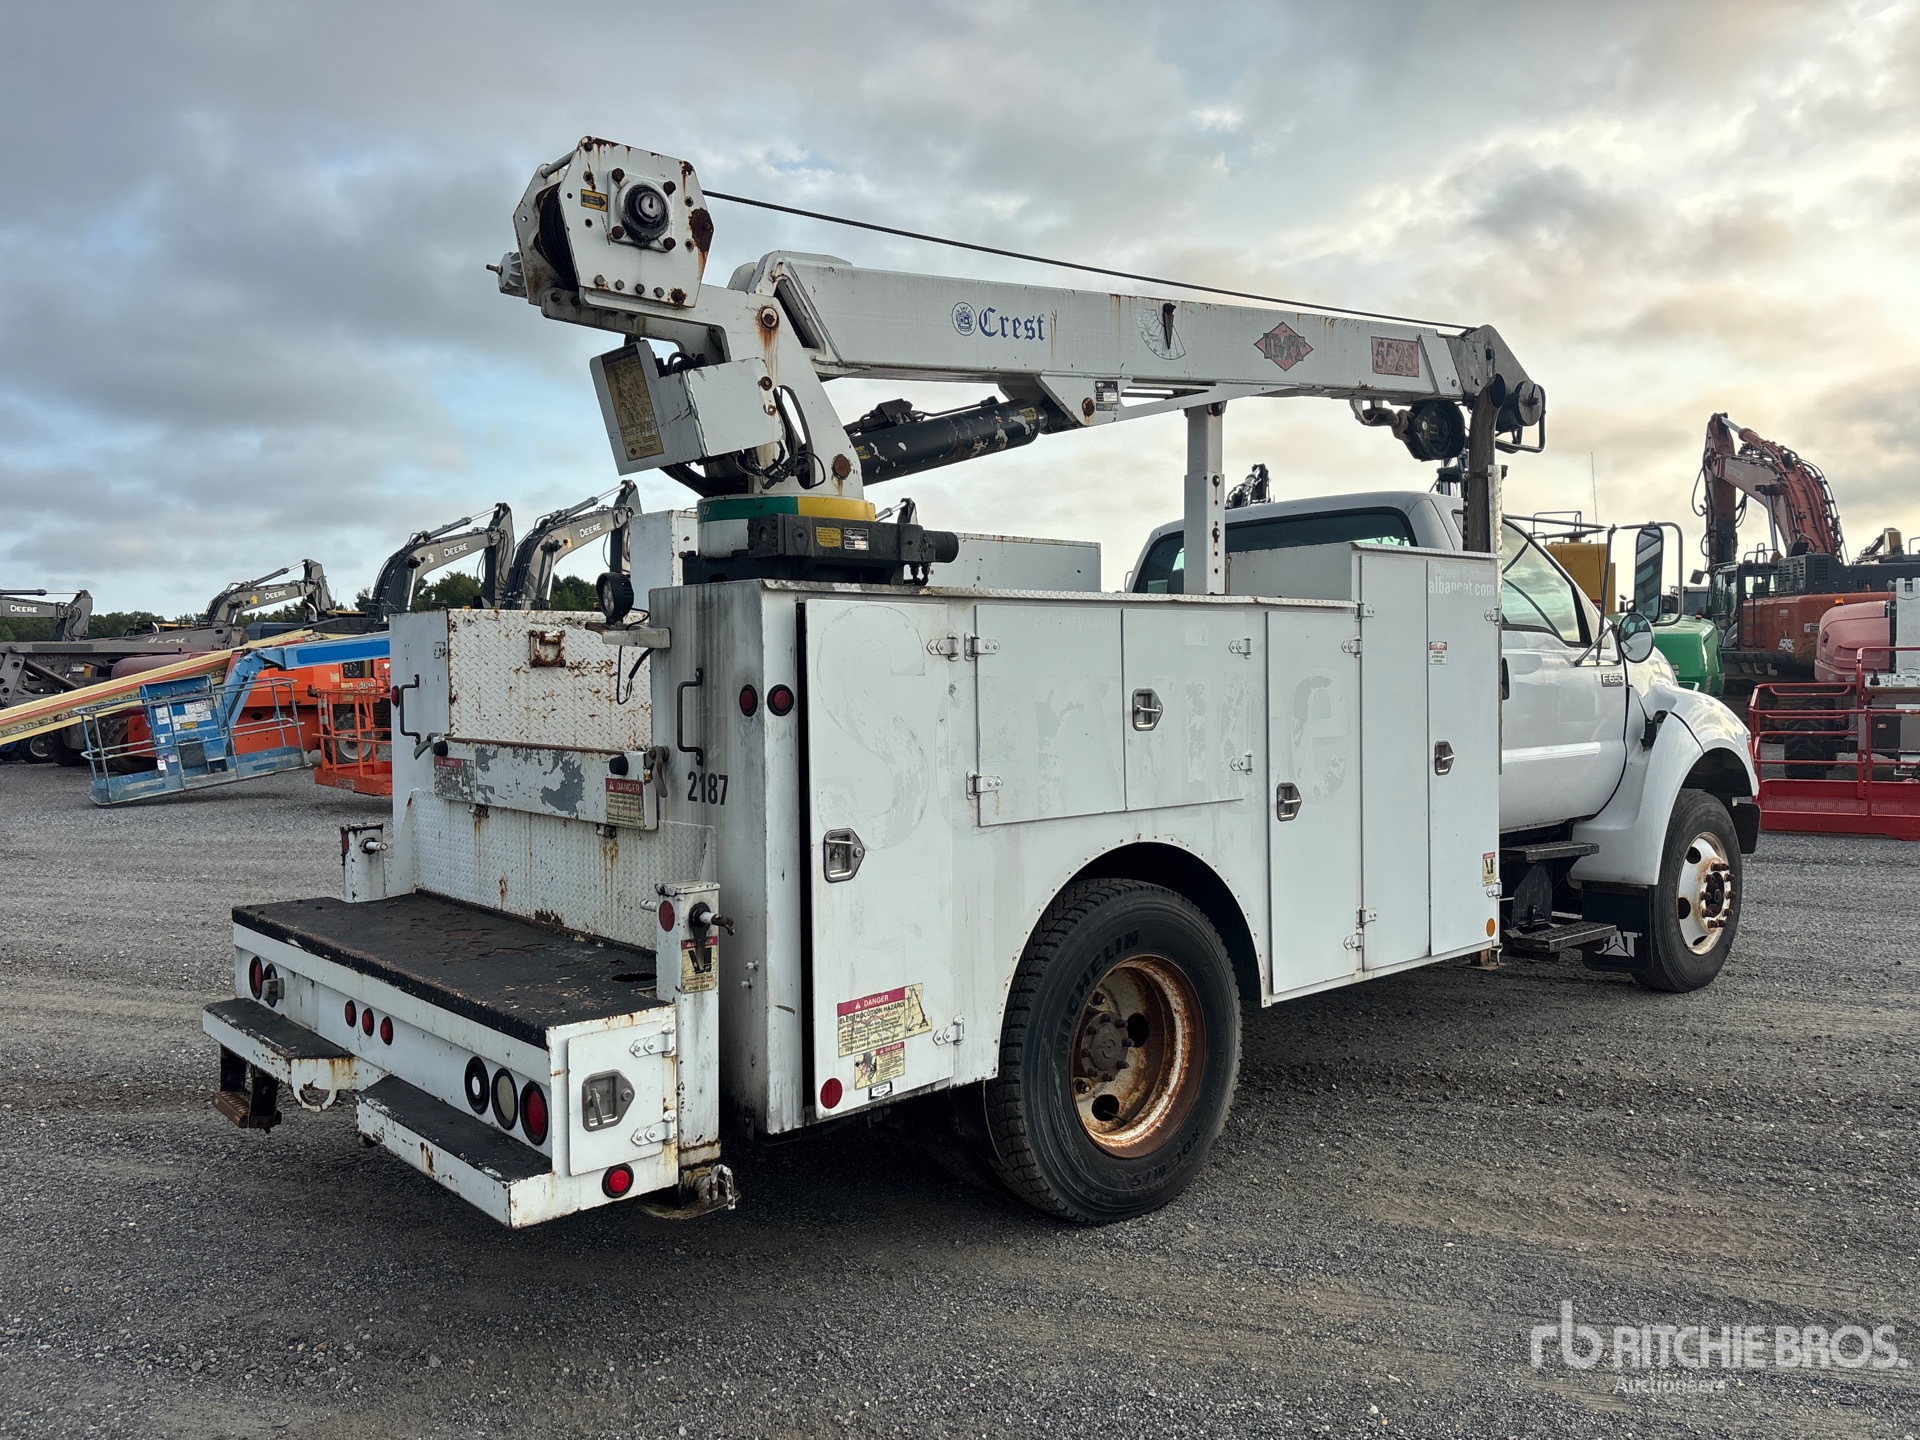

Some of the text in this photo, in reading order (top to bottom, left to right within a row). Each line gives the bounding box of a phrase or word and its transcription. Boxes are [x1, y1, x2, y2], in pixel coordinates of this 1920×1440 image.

[978, 306, 1045, 342] Crest
[579, 523, 602, 538] DEERE
[443, 542, 469, 558] DEERE
[264, 589, 287, 600] DEERE
[10, 604, 38, 613] DEERE
[616, 782, 640, 793] DANGER
[687, 770, 729, 806] 2187
[864, 994, 889, 1007] DANGER
[1055, 928, 1141, 1061] MICHELIN
[839, 1000, 905, 1025] ELECTROCUTION HAZARD
